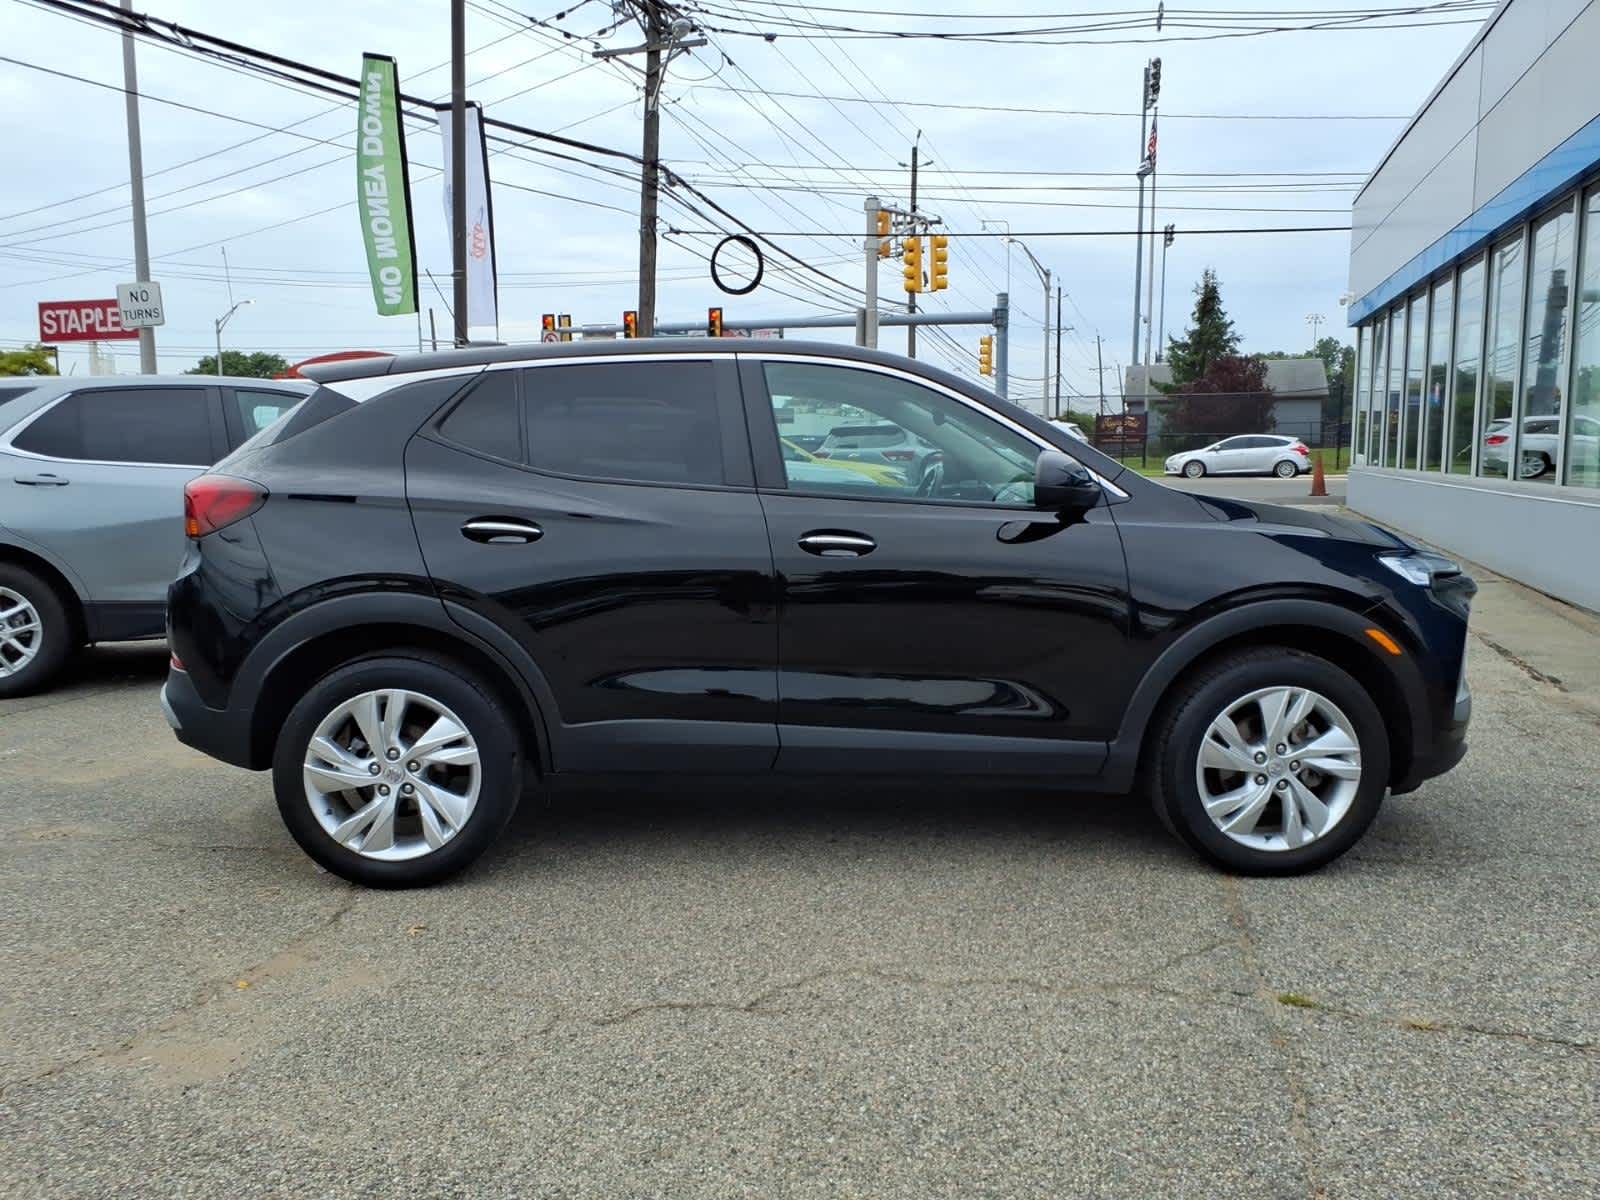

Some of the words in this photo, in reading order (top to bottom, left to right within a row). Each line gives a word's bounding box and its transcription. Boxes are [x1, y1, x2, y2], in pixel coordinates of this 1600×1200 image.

[129, 289, 149, 303] NO
[42, 306, 134, 335] STAPLE
[122, 307, 160, 321] TURNS
